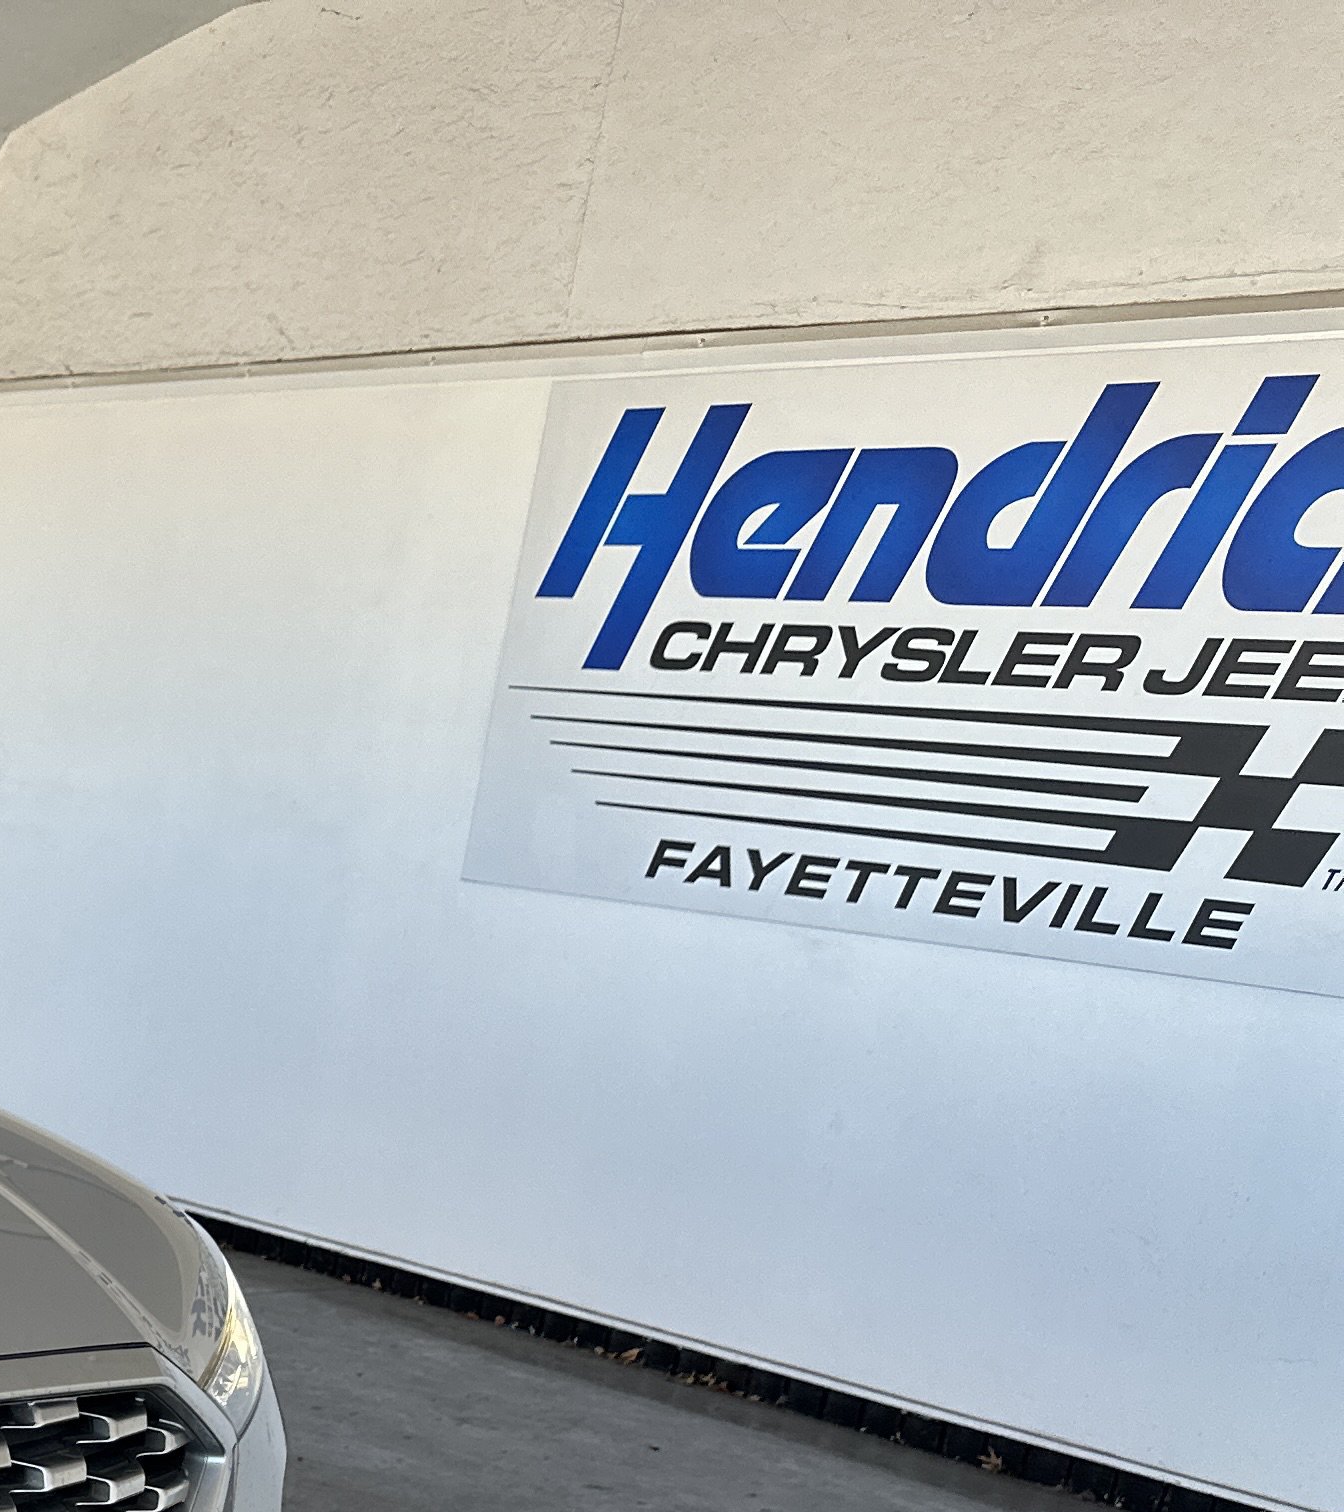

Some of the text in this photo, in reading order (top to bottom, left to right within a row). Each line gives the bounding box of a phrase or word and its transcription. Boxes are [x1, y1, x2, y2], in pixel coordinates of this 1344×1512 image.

[534, 374, 1344, 670] Hendric
[649, 621, 1344, 702] CHRYSLER JEE
[645, 839, 1256, 950] FAYETTEVILLE
